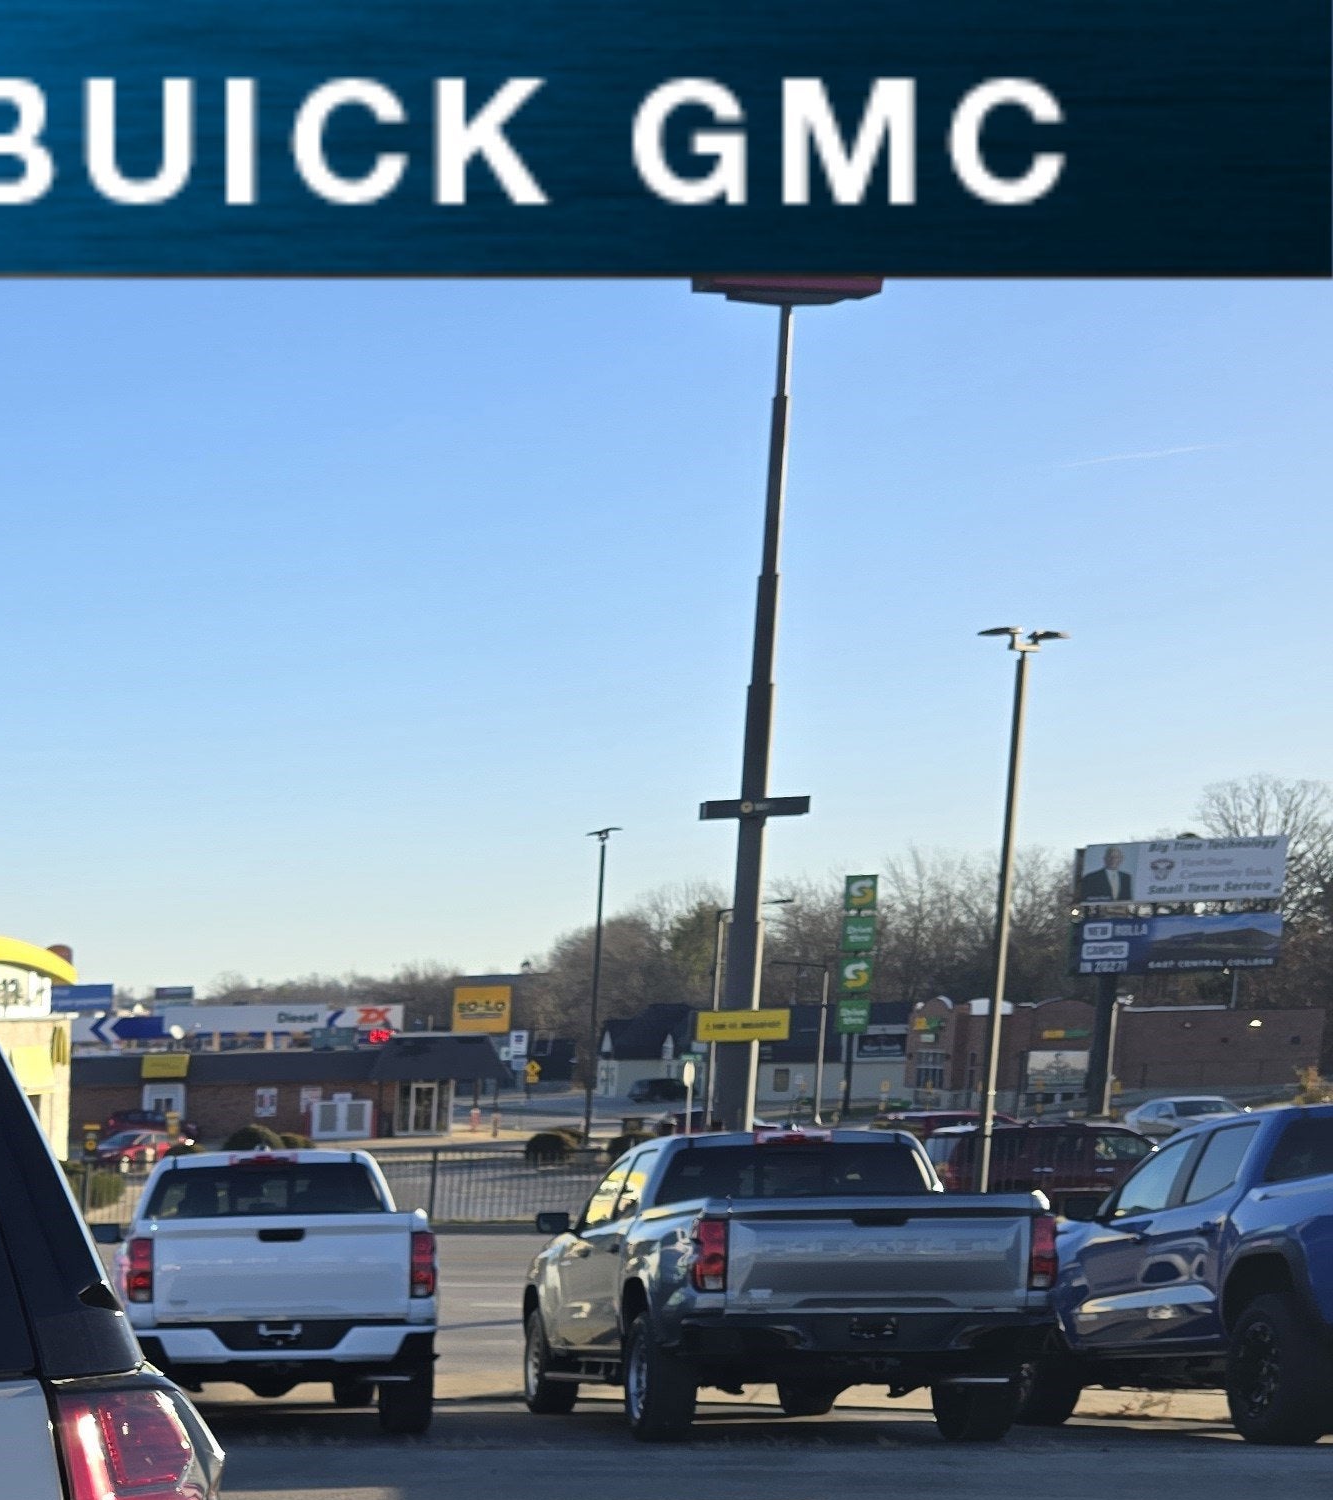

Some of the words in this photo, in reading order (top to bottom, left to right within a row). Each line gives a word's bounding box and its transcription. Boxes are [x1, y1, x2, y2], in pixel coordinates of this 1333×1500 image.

[1147, 842, 1169, 853] Big
[1174, 840, 1203, 850] Time
[1207, 837, 1278, 850] Technology
[1245, 866, 1273, 877] Bank
[1147, 883, 1183, 895] Small
[1187, 882, 1220, 894] Town
[1222, 881, 1273, 892] Service
[1177, 958, 1224, 968] CENTRAL
[1226, 957, 1274, 967] COLLEGE
[276, 1011, 320, 1024] Diesel
